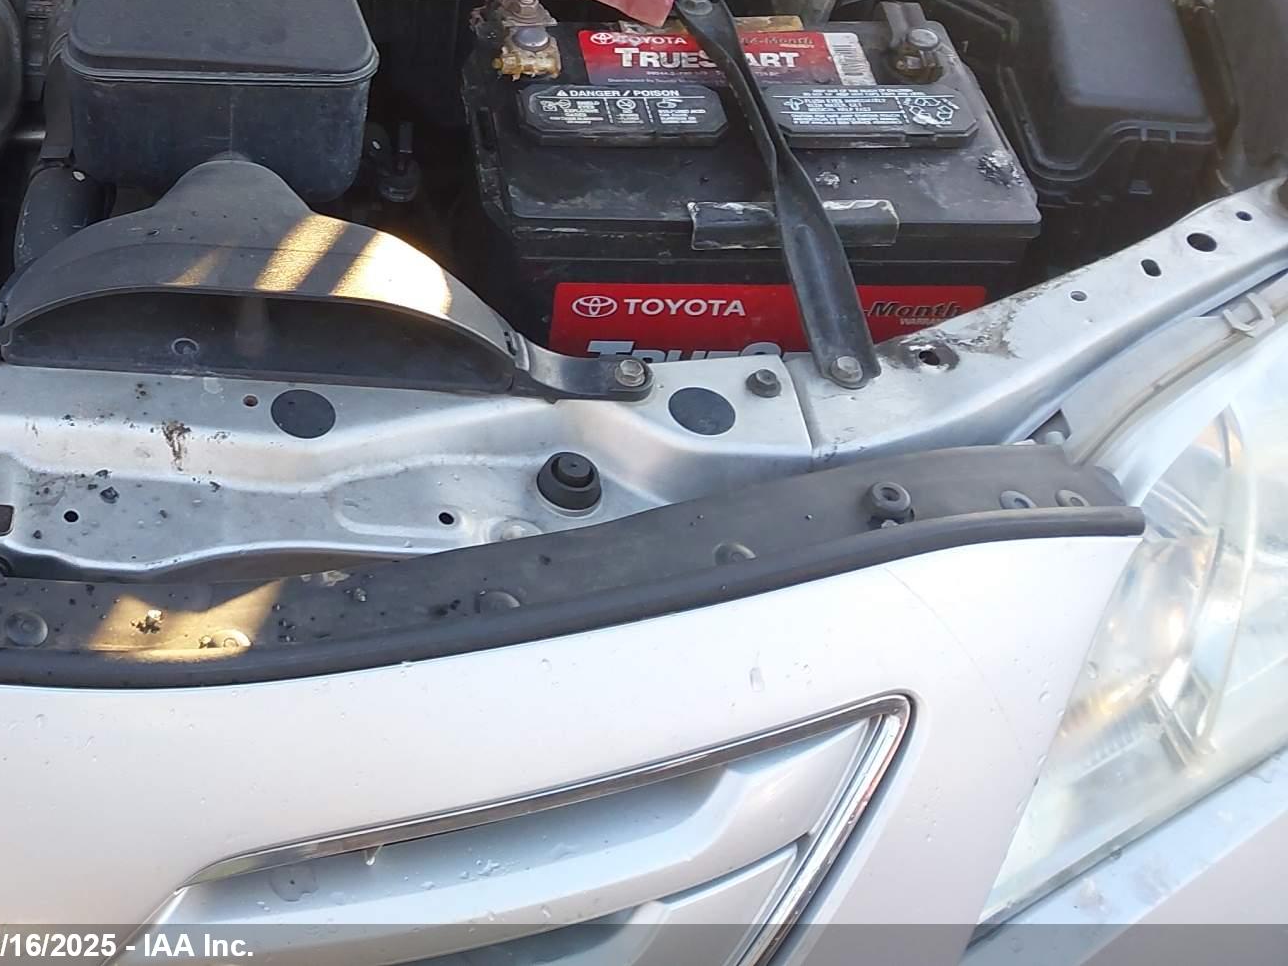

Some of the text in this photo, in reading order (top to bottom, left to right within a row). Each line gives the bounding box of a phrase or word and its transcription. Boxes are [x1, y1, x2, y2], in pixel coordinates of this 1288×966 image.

[614, 35, 688, 45] TOYOTA
[614, 47, 800, 68] TRUESART
[569, 89, 623, 97] DANGER
[633, 89, 680, 97] POISON
[623, 297, 747, 317] TOYOTA
